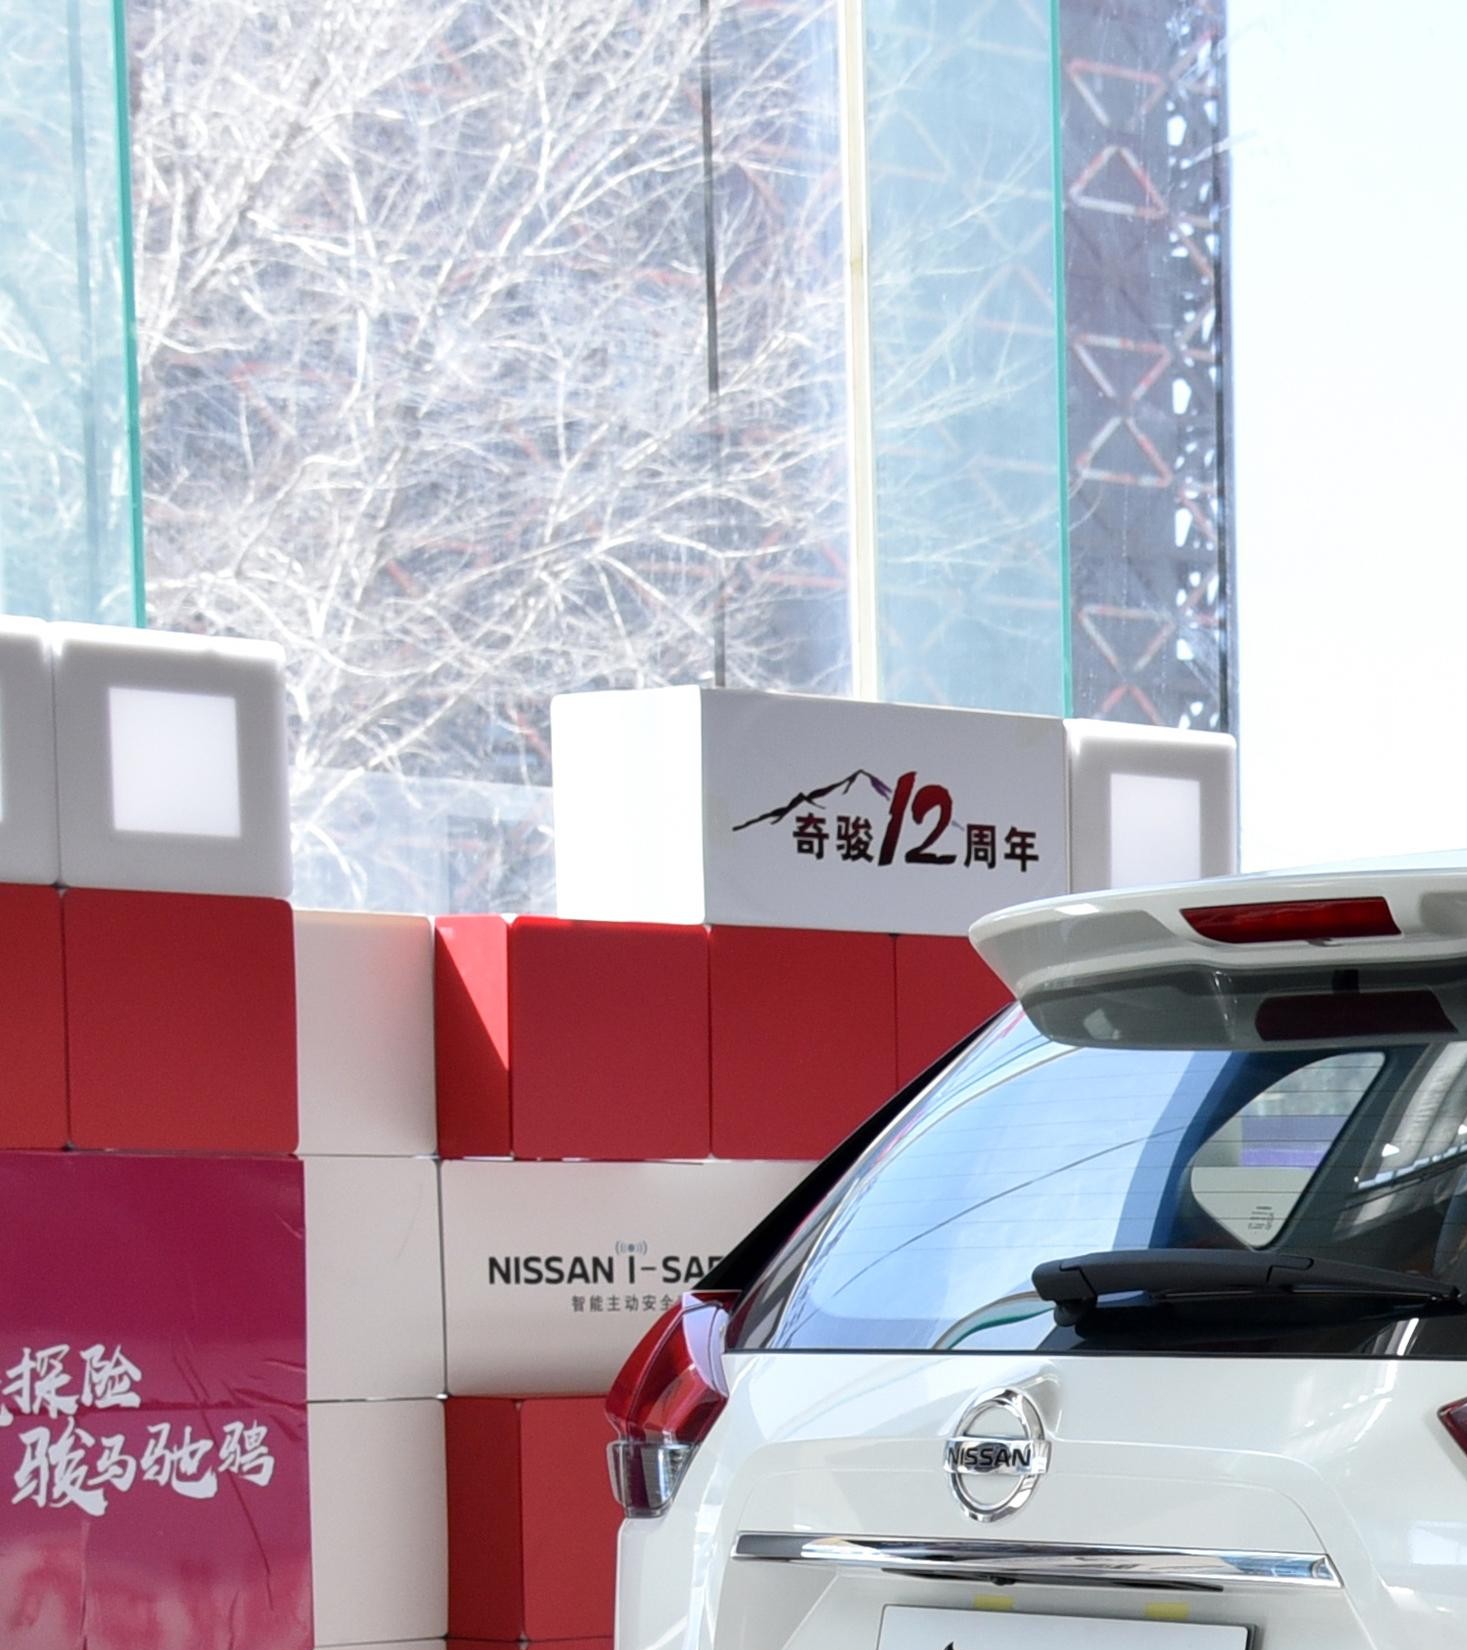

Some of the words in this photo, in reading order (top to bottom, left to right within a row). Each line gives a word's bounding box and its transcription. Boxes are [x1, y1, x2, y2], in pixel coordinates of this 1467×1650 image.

[488, 1256, 614, 1284] NISSAN
[571, 1295, 681, 1312] 智能主动安全
[0, 1344, 142, 1426] 探险
[946, 1447, 1031, 1468] NISSAN
